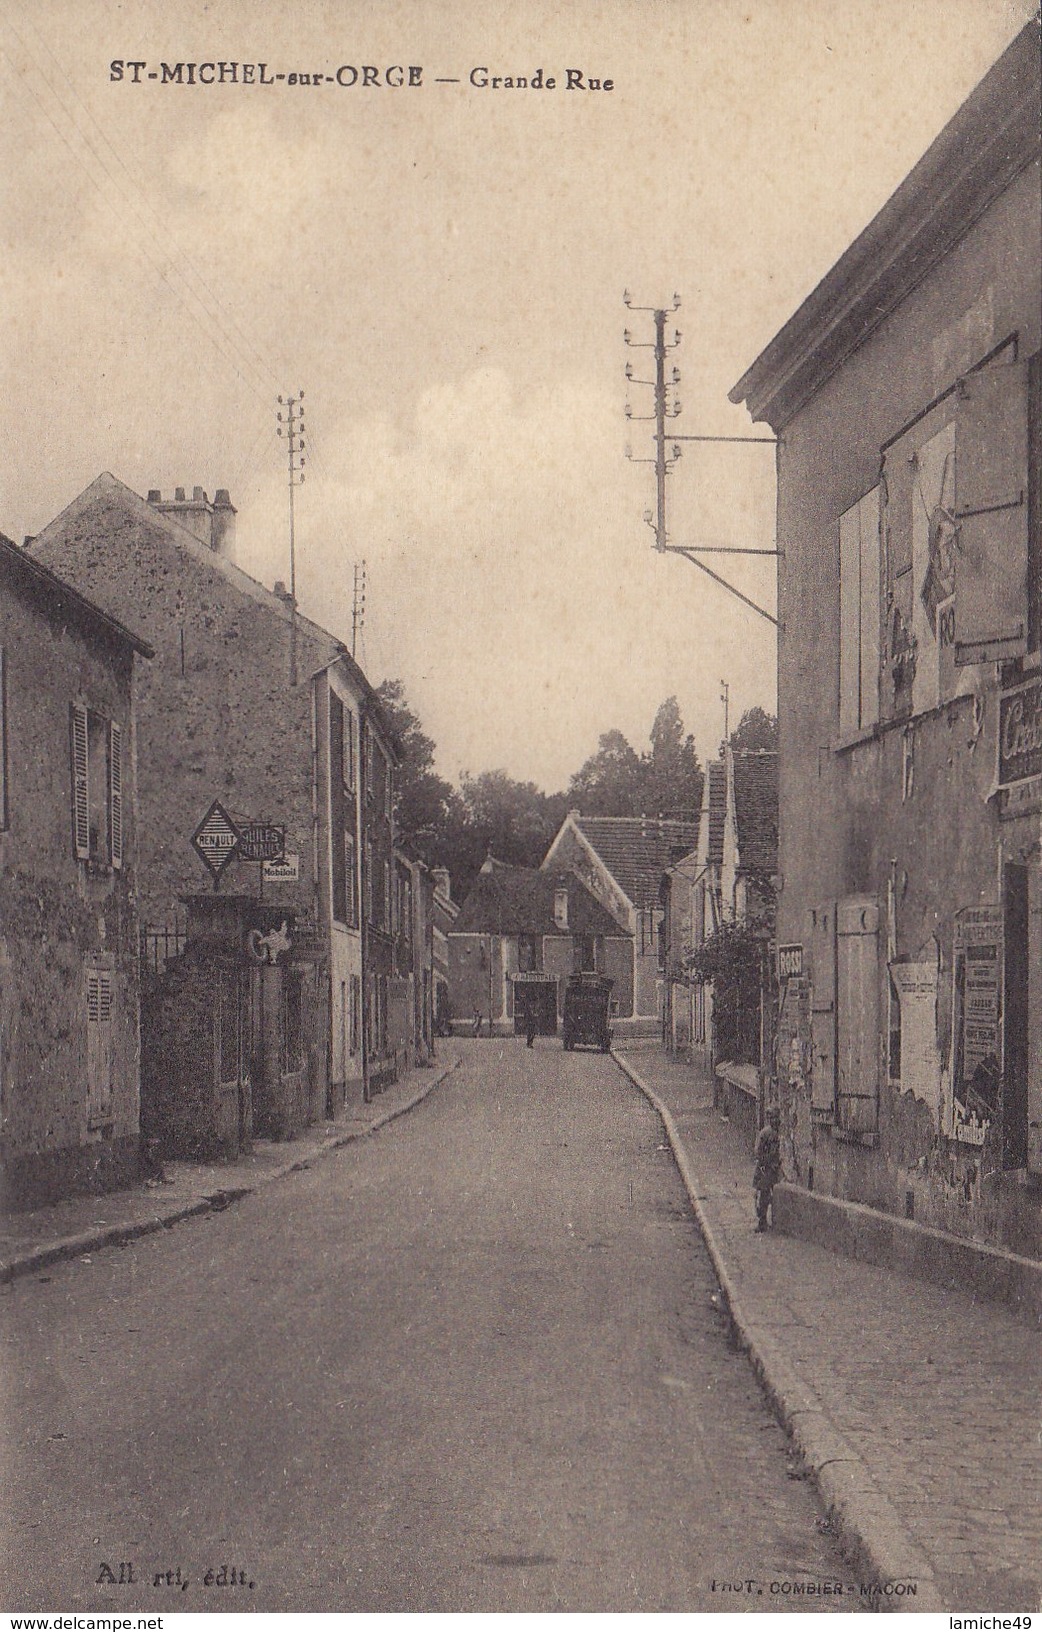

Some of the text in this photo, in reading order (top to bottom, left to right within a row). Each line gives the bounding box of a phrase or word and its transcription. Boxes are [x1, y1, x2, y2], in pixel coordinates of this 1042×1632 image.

[110, 59, 425, 88] ST-MICHEL-sur-ORGE
[469, 67, 556, 90] Grande
[565, 68, 615, 91] Rue
[200, 833, 235, 848] RENAULT
[263, 867, 297, 878] Mobiloil
